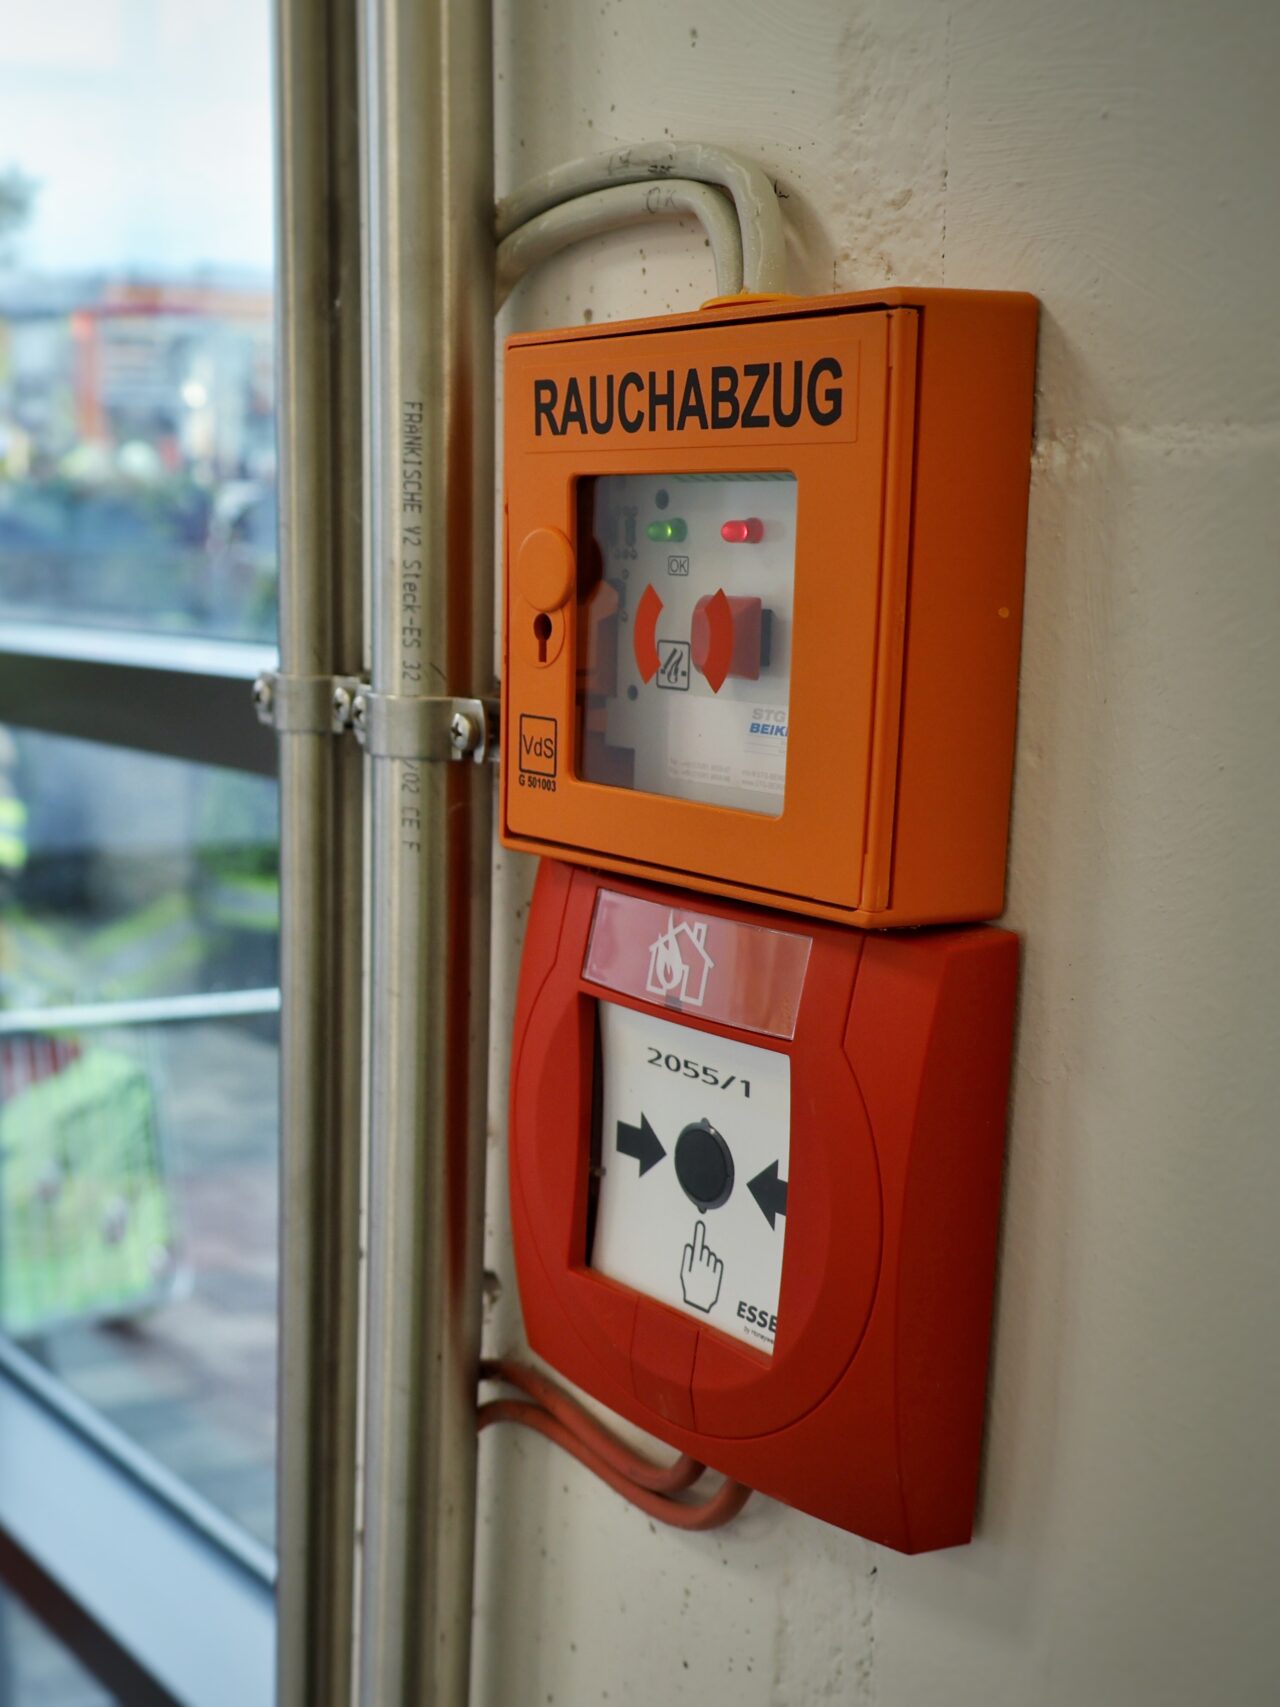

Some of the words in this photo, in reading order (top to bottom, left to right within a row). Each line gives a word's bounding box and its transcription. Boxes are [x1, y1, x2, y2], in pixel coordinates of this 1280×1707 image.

[534, 357, 843, 436] RAUCHABZUG
[670, 558, 688, 573] OK
[402, 660, 421, 683] 32
[523, 734, 554, 759] VdS
[519, 774, 526, 787] G
[528, 775, 557, 792] 501003
[647, 1046, 751, 1099] 2055/1
